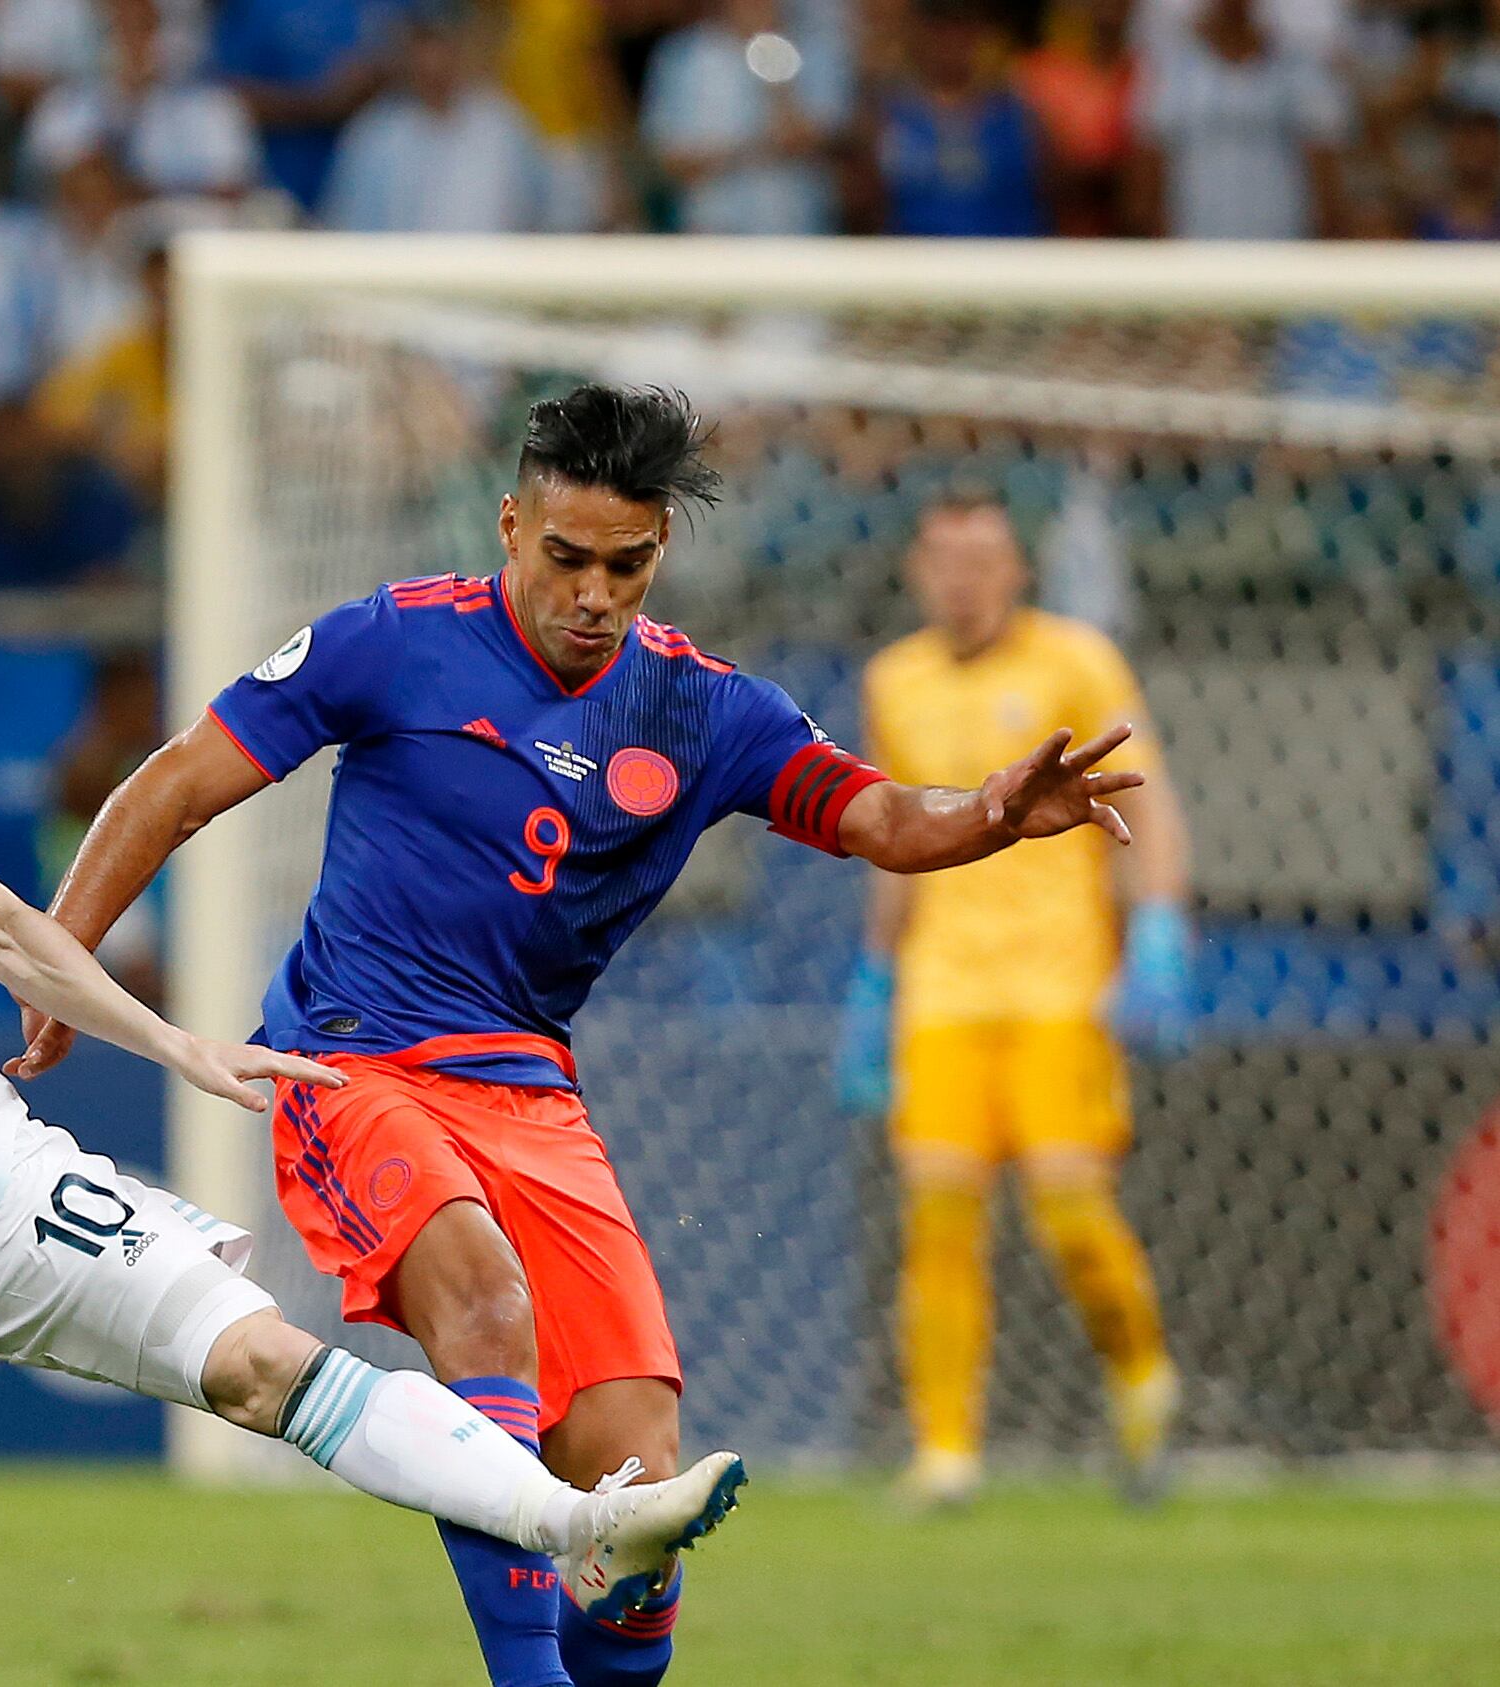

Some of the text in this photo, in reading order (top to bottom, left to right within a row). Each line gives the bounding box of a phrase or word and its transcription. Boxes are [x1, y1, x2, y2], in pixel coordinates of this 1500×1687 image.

[508, 806, 569, 895] 9
[34, 1172, 136, 1258] 10
[126, 1231, 160, 1268] adidas
[509, 1567, 558, 1590] FCF
